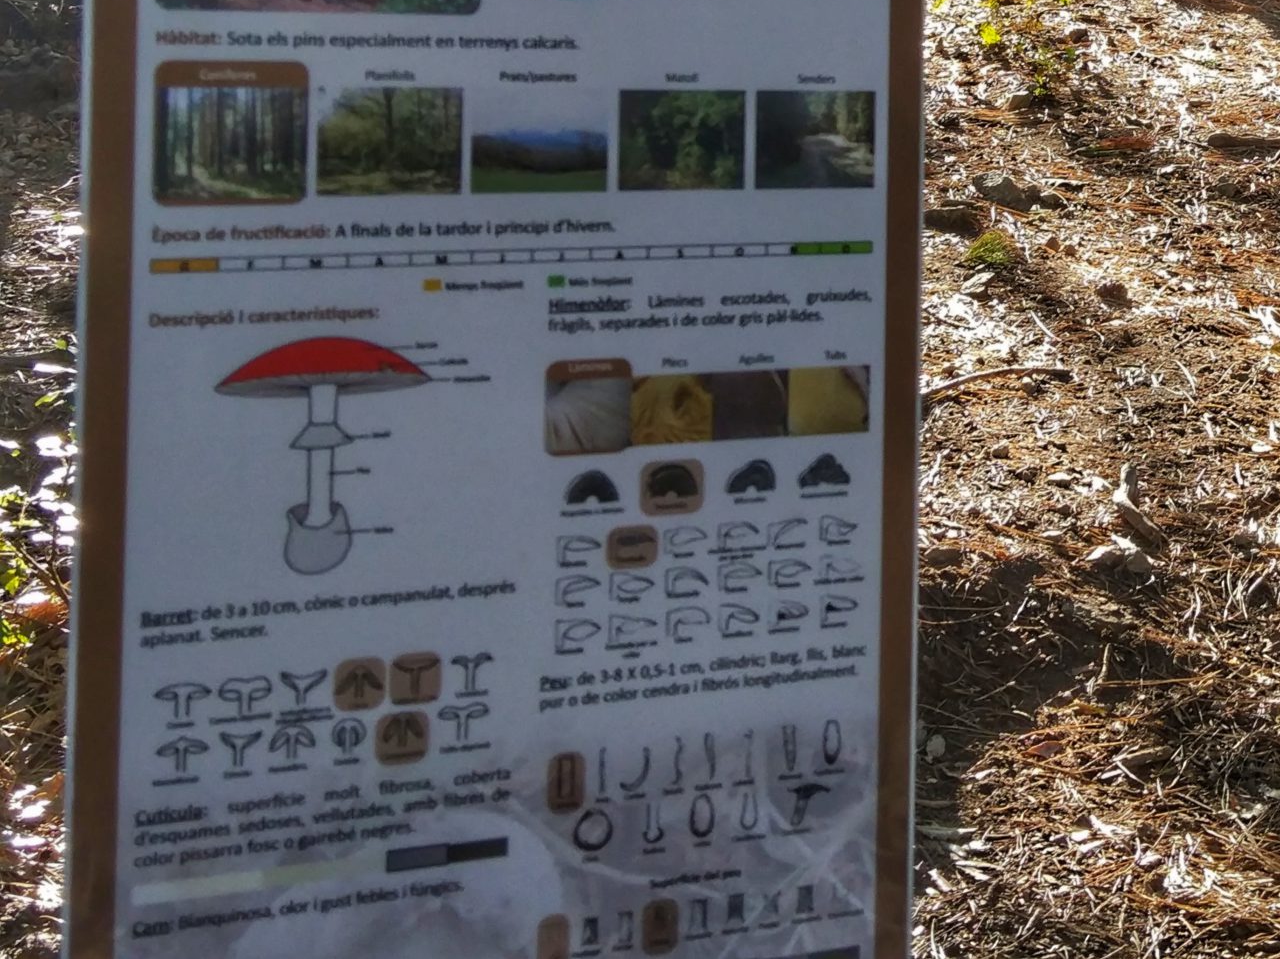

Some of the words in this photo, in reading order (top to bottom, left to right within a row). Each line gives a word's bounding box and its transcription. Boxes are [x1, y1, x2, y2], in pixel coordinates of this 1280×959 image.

[156, 30, 221, 45] Hàbitat:
[227, 31, 262, 46] Sota
[267, 31, 288, 46] els
[293, 31, 325, 48] pins
[329, 33, 431, 52] especialment
[435, 37, 454, 48] en
[458, 36, 519, 51] terrenys
[522, 36, 579, 50] calcaris.
[206, 227, 226, 240] de
[230, 224, 331, 241] fructificació:
[335, 224, 347, 238] A
[351, 223, 391, 238] finals
[395, 222, 414, 236] de
[418, 222, 432, 236] la
[436, 221, 482, 236] tardor
[495, 220, 548, 238] principi
[552, 219, 616, 234] d'hivern.
[720, 291, 792, 307] escotades,
[149, 311, 235, 328] Descripció
[248, 307, 381, 324] característiques:
[599, 315, 670, 332] separades
[680, 314, 699, 327] de
[702, 312, 736, 326] color
[739, 312, 764, 327] gris
[201, 605, 223, 621] de
[225, 603, 236, 619] 3
[252, 600, 272, 617] 10
[348, 595, 359, 608] o
[361, 584, 454, 607] campanulat,
[211, 624, 269, 641] Sencer.
[576, 670, 596, 687] de
[600, 667, 623, 685] 3-8
[679, 661, 705, 676] cm,
[832, 644, 867, 660] blanc
[539, 696, 564, 715] pur
[568, 695, 578, 708] o
[581, 692, 599, 707] de
[603, 686, 638, 703] color
[641, 681, 690, 700] cendra
[324, 783, 360, 802] molt
[453, 768, 512, 788] coberta
[402, 795, 438, 814] amb
[491, 787, 512, 803] de
[133, 850, 176, 869] color
[246, 837, 280, 854] fosc
[283, 837, 295, 850] o
[321, 894, 351, 915] gust
